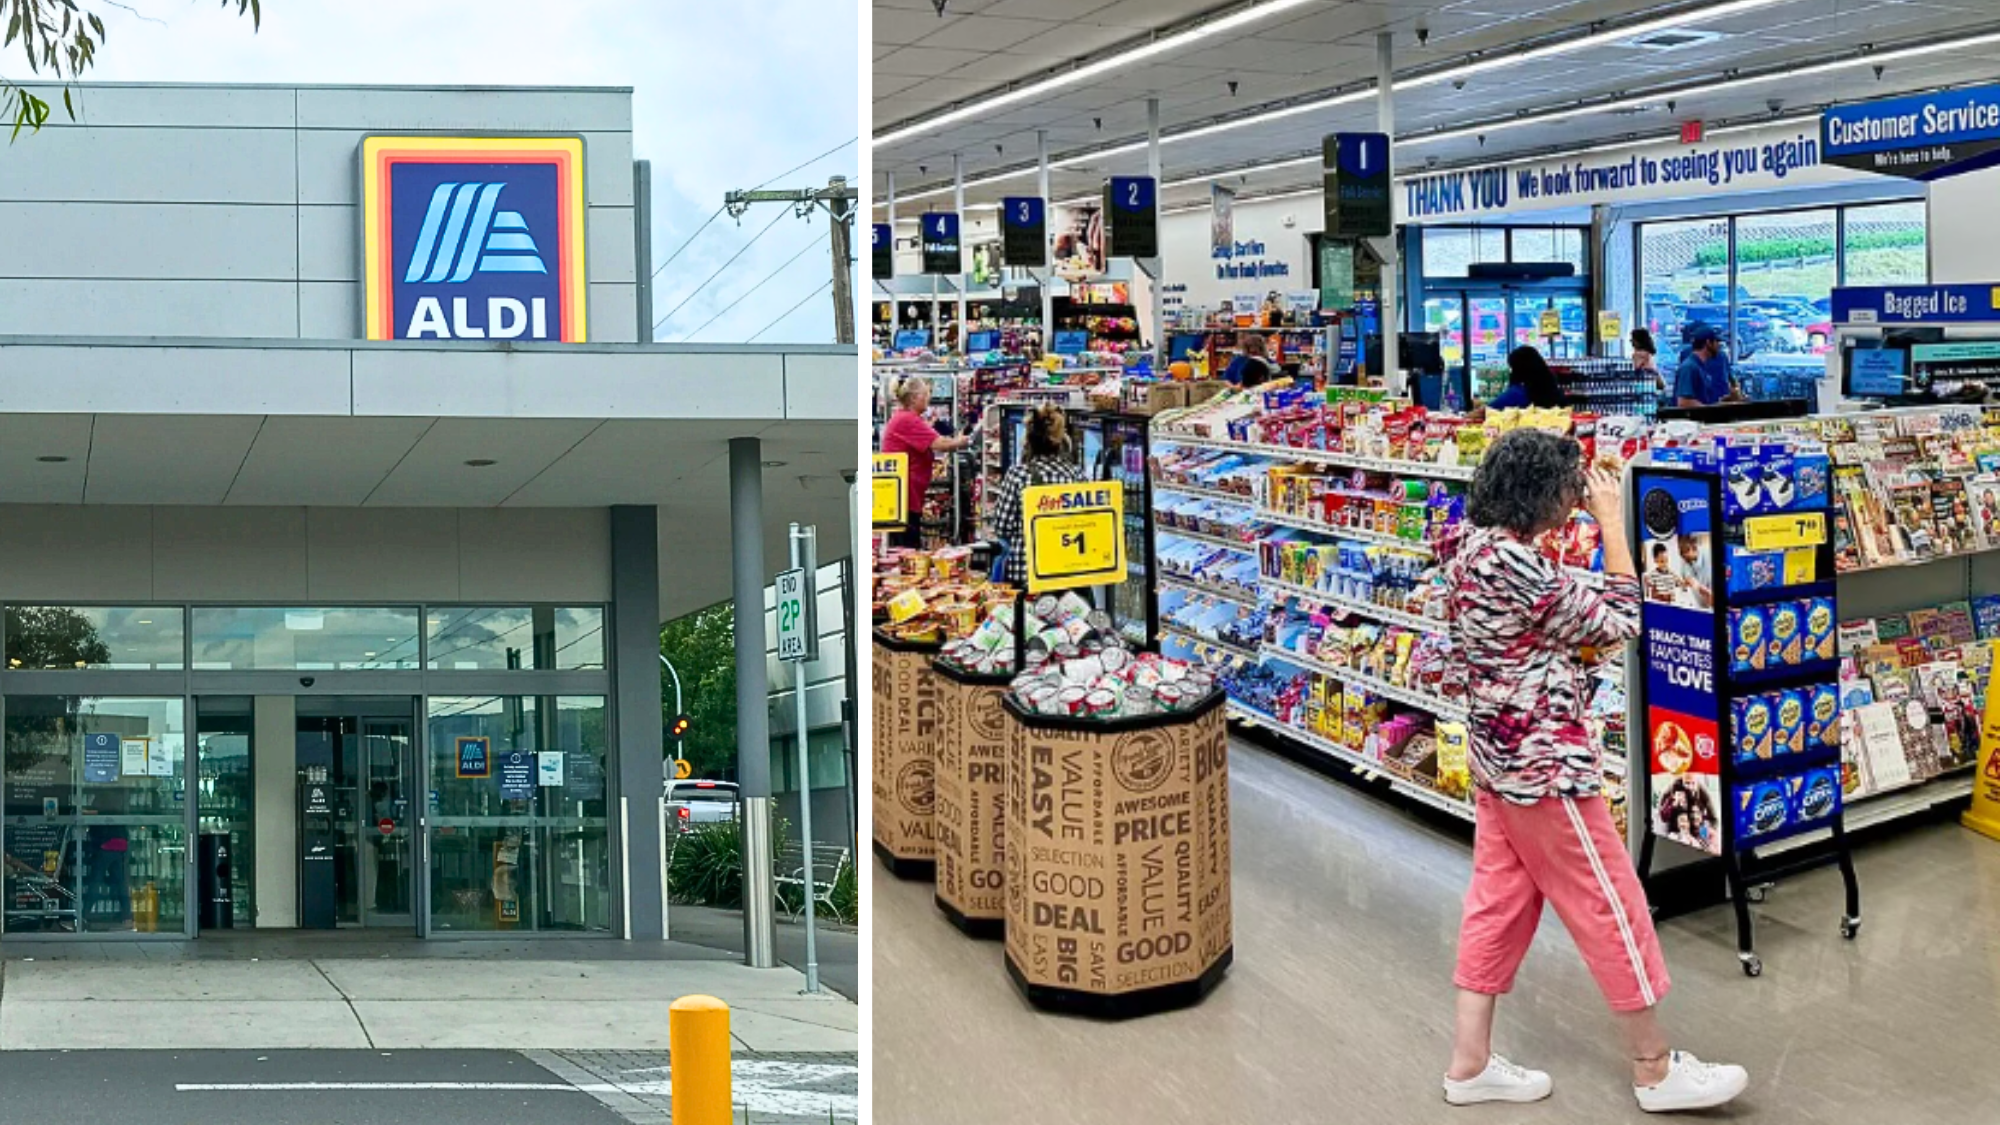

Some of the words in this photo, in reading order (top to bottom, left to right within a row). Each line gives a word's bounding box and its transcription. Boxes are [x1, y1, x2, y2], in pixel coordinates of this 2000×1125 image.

[1829, 113, 1919, 146] Customer
[1922, 100, 1999, 135] Service
[1359, 140, 1367, 170] 1
[1874, 151, 1897, 167] We're
[1921, 150, 1930, 163] to
[1404, 172, 1465, 217] THANK
[1469, 166, 1509, 210] YOU
[1516, 169, 1539, 199] We
[1541, 164, 1573, 196] look
[1574, 155, 1636, 193] forward
[1640, 155, 1657, 185] to
[1661, 149, 1719, 185] seeing
[1723, 147, 1758, 183] you
[1761, 134, 1818, 179] again
[1128, 182, 1138, 206] 2
[936, 215, 946, 236] 4
[1018, 202, 1030, 223] 3
[406, 296, 548, 338] ALDI
[1884, 291, 1938, 318] Bagged
[1944, 290, 1968, 313] Ice
[1062, 489, 1111, 509] SALE!
[1061, 531, 1085, 554] $1
[782, 577, 797, 594] END
[780, 599, 800, 632] 2P
[782, 636, 803, 654] AREA
[1651, 641, 1713, 670] FAVORITES
[1687, 634, 1712, 653] TIME
[899, 652, 911, 693] OOD
[1667, 662, 1713, 693] LOVE
[461, 761, 485, 770] ALDI
[1180, 727, 1190, 783] ARIETY
[1195, 730, 1228, 785] BIG
[1032, 746, 1053, 840] EASY
[1062, 750, 1084, 840] VALUE
[1093, 750, 1104, 846] AFFORDABLE
[1115, 791, 1190, 816] AWESOME
[1115, 810, 1191, 846] PRICE
[1031, 846, 1104, 869] SELECTION
[1033, 870, 1104, 900] GOOD
[1117, 853, 1128, 937] AFFORDABLE
[1141, 844, 1164, 931] VALUE
[1175, 841, 1192, 922] QUALITY
[1033, 901, 1106, 935] DEAL
[1033, 935, 1048, 979] EASY
[1057, 937, 1078, 984] BIG
[1116, 931, 1193, 964] GOOD
[1091, 942, 1106, 989] SAVE
[1117, 961, 1194, 988] SELECTION
